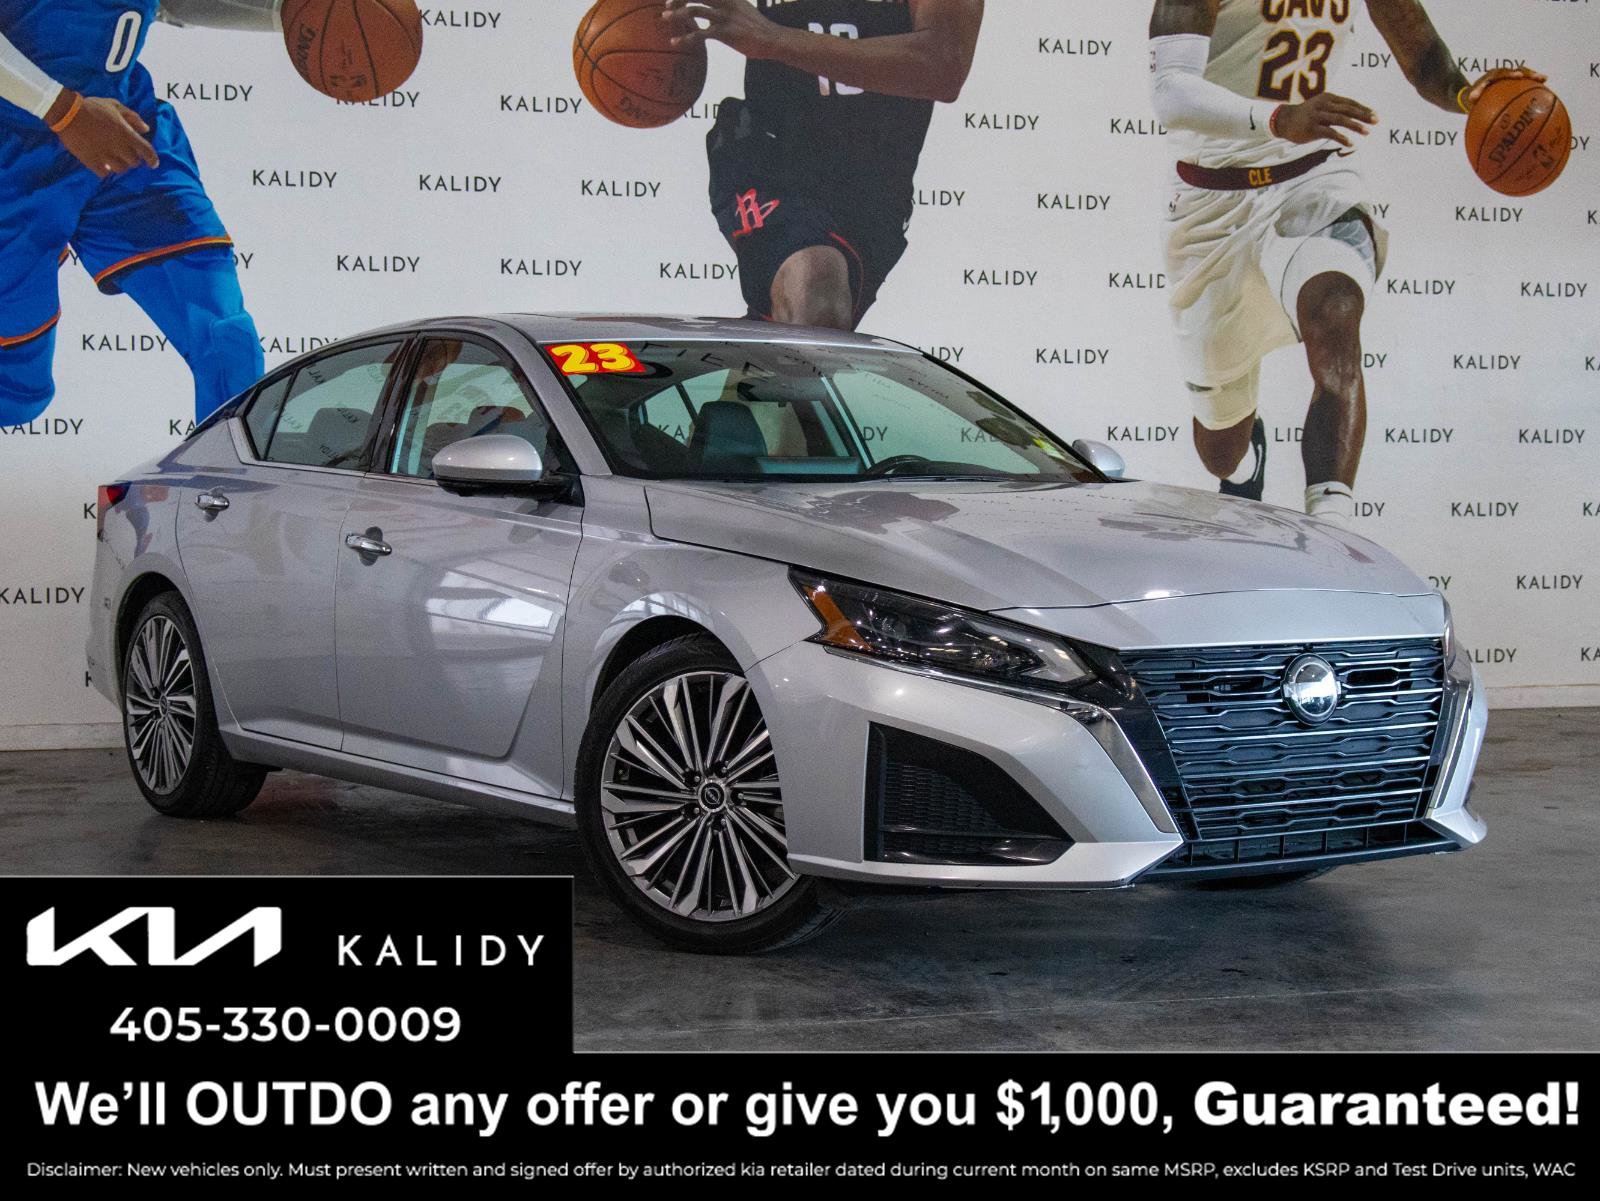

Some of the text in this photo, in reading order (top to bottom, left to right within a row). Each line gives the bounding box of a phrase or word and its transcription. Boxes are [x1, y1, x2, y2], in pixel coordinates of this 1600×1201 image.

[420, 10, 500, 28] KALIDY
[106, 10, 142, 73] 0
[1039, 38, 1111, 55] KALIDY
[1257, 29, 1335, 101] 23
[167, 83, 253, 101] KALIDY
[501, 95, 582, 113] KALIDY
[966, 113, 1039, 130] KALIDY
[1111, 119, 1168, 135] KALID
[1390, 130, 1457, 145] KALIDY
[253, 170, 336, 188] KALIDY
[420, 175, 501, 192] KALIDY
[1248, 167, 1272, 187] CLE
[582, 180, 660, 197] KALIDY
[1038, 194, 1110, 210] KALIDY
[1456, 206, 1522, 222] KALIDY
[338, 255, 419, 272] KALIDY
[501, 259, 581, 276] KALIDY
[660, 262, 738, 280] KALIDY
[964, 269, 1037, 285] KALIDY
[1109, 273, 1166, 289] KALID
[1388, 279, 1455, 294] KALIDY
[1521, 282, 1587, 297] KALIDY
[82, 335, 167, 352] KALIDY
[551, 344, 636, 374] 23
[1037, 349, 1108, 364] KALIDY
[1454, 355, 1520, 369] KALIDY
[1108, 426, 1179, 441] KALIDY
[1386, 428, 1453, 443] KALIDY
[1519, 429, 1584, 443] KALIDY
[1452, 502, 1518, 516] KALIDY
[1517, 575, 1582, 589] KALIDY
[0, 587, 85, 604] KALIDY
